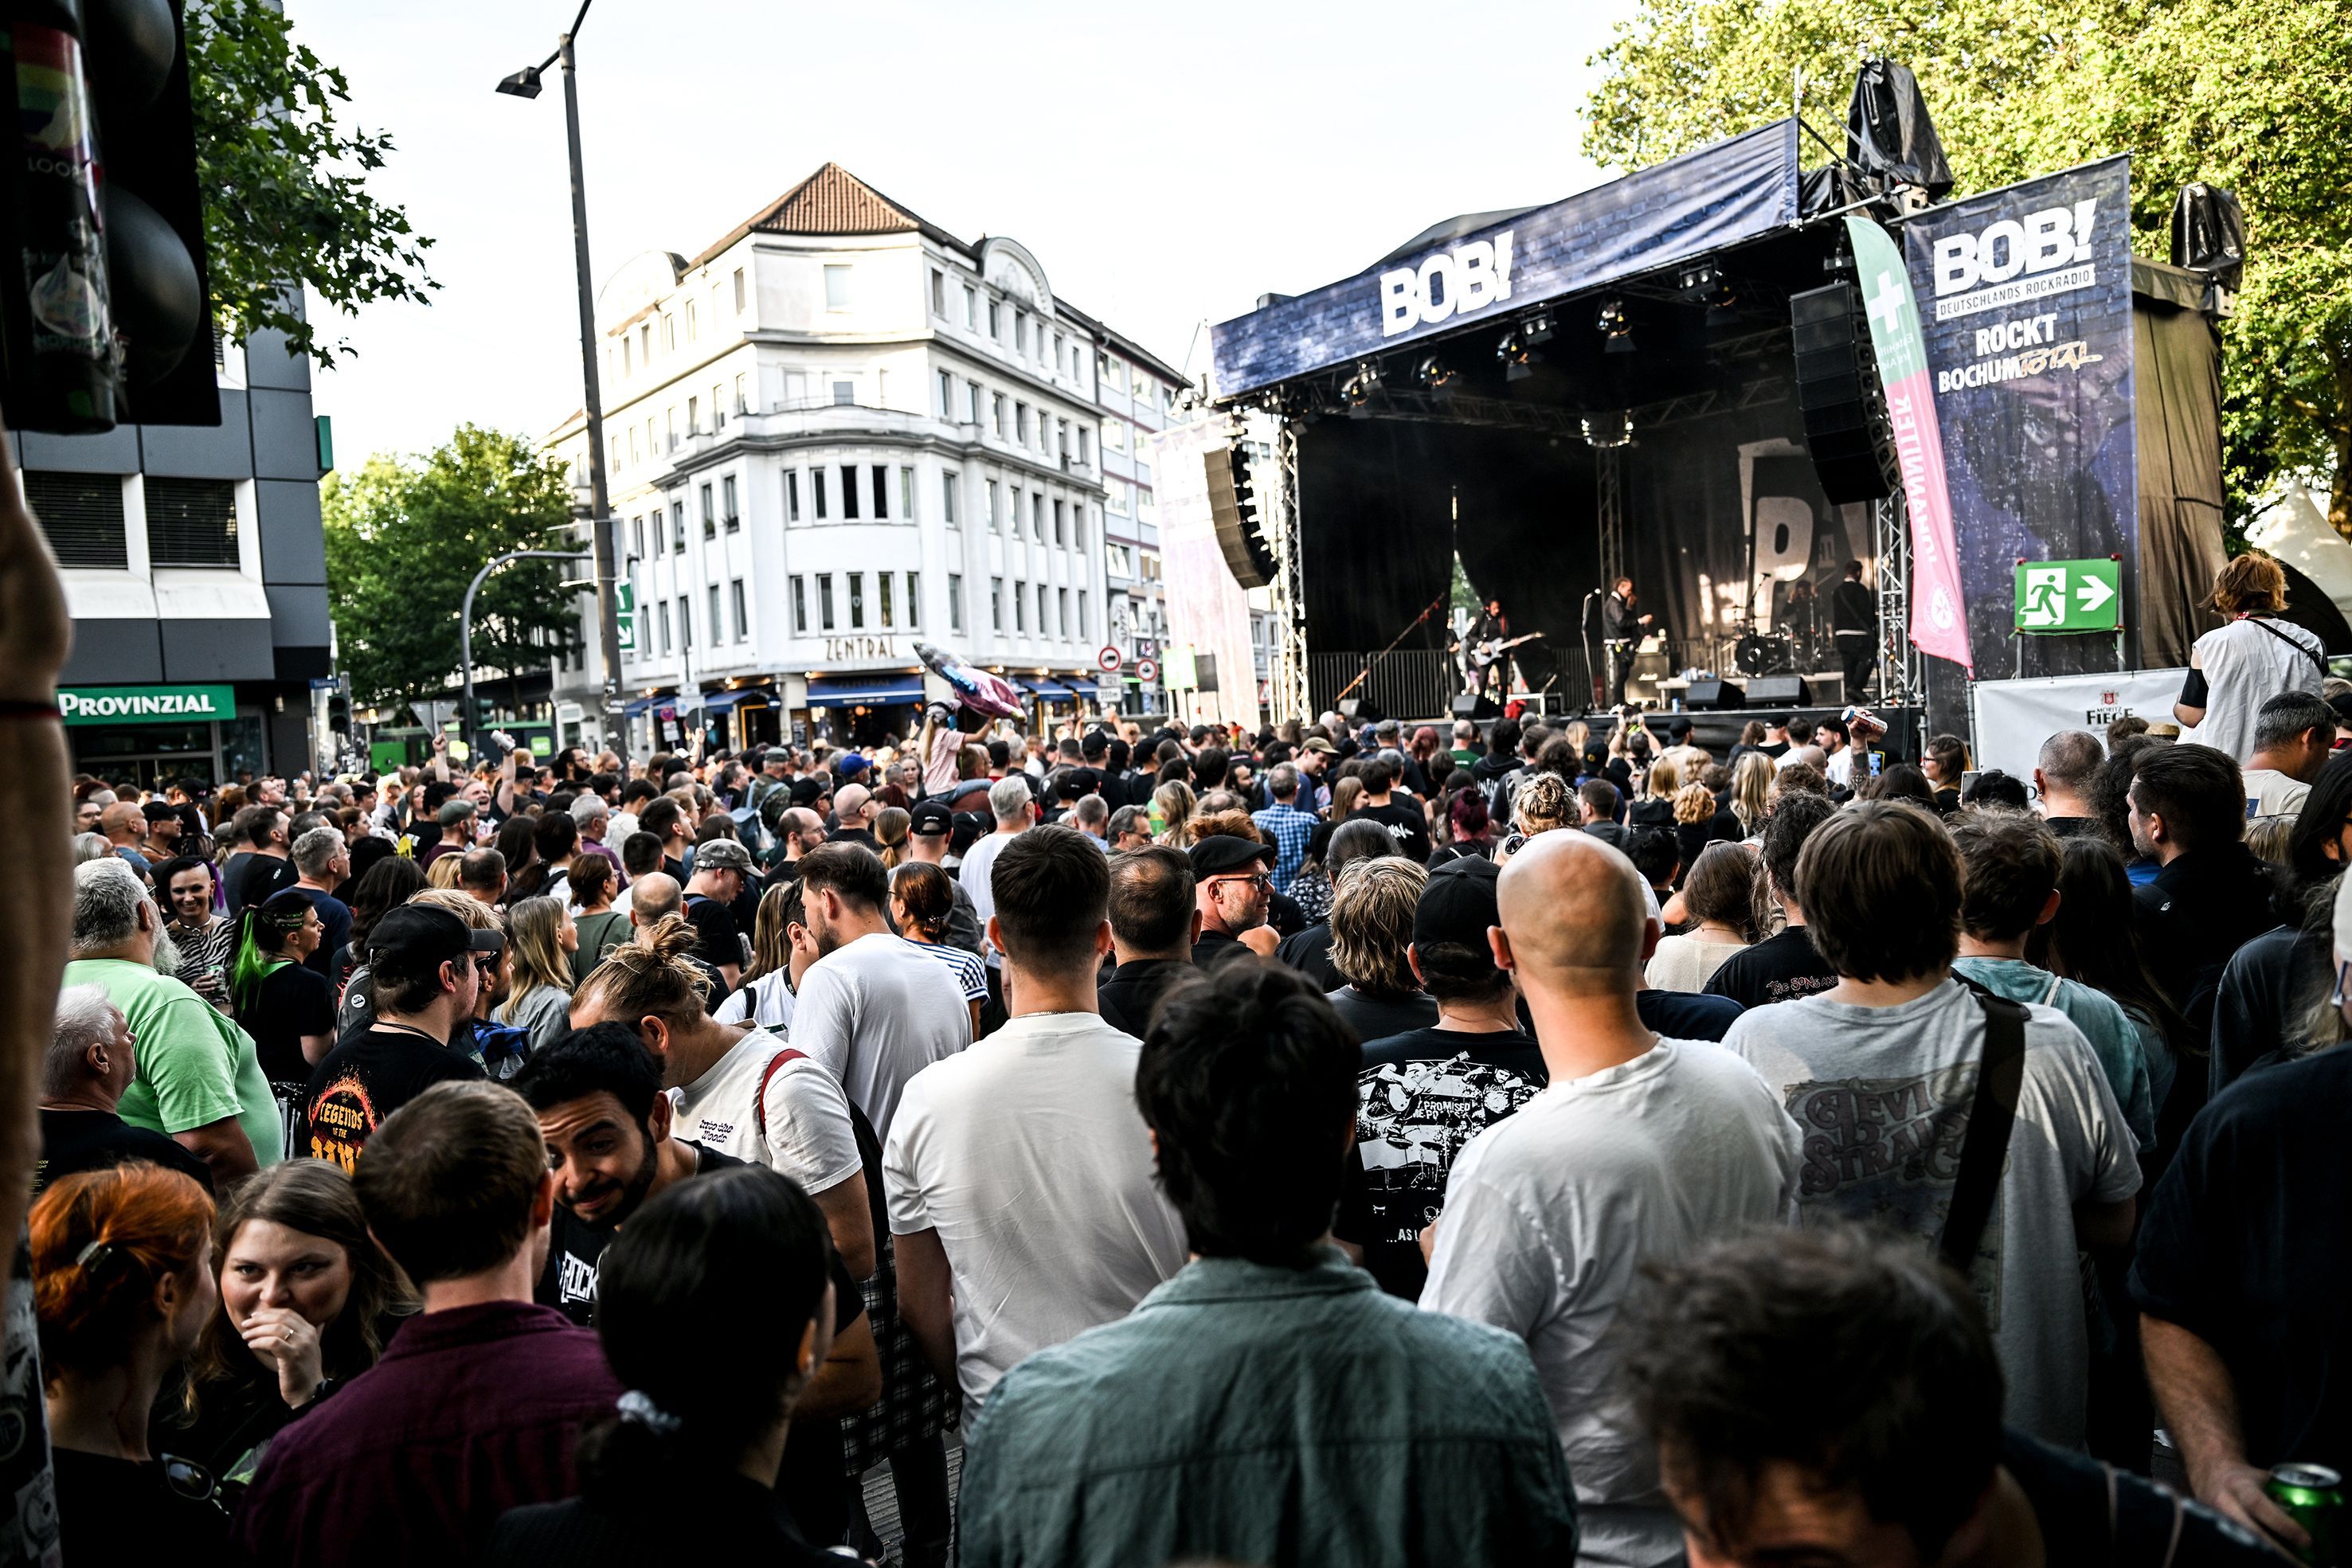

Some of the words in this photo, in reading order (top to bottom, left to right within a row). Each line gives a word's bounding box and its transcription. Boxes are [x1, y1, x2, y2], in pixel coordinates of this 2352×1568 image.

[1933, 197, 2097, 296] BOB!
[1380, 229, 1514, 338] BOB!
[1940, 287, 2021, 316] DEUTSCHLANDS
[2026, 269, 2090, 295] ROCKRADIO
[1976, 312, 2057, 357] ROCKT
[826, 636, 896, 661] ZENTRAL
[58, 693, 217, 717] PROVINZIAL
[1790, 976, 1821, 991] SONS
[1821, 976, 1839, 987] AND
[319, 1102, 364, 1131] LEGENDS
[1424, 1101, 1471, 1112] PROMISED
[1806, 1081, 1933, 1148] LEVI
[718, 1122, 734, 1133] the
